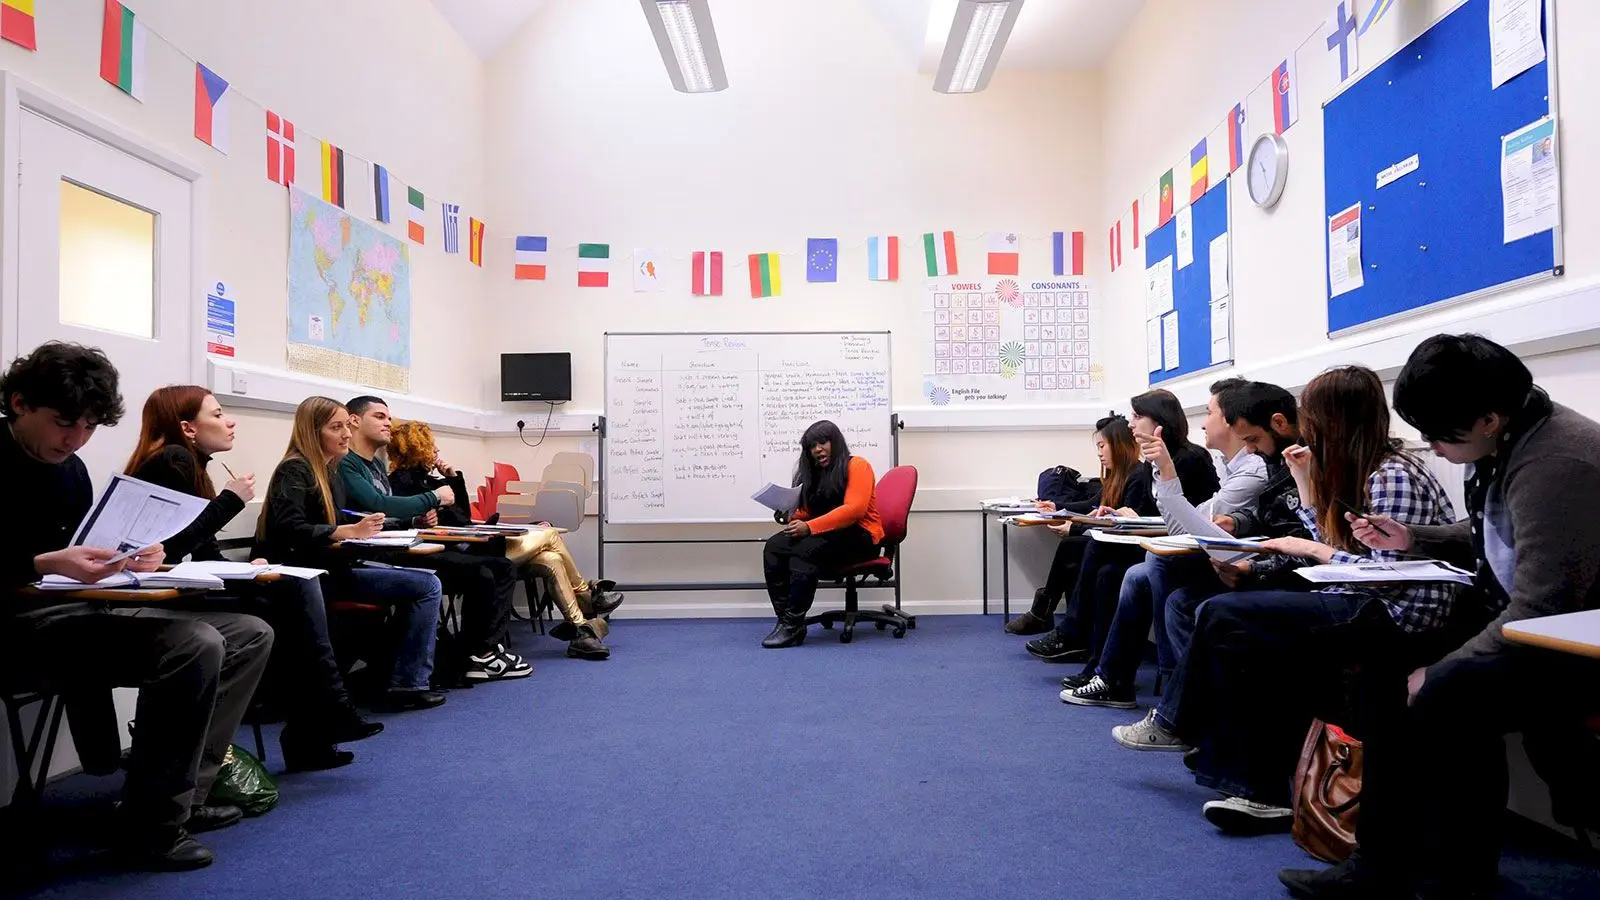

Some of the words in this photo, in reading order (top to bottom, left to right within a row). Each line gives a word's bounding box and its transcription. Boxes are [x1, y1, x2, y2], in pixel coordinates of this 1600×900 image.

[951, 283, 982, 291] VOWELS
[1031, 282, 1080, 290] CONSONANTS
[951, 388, 970, 396] English
[987, 393, 1008, 401] talking!
